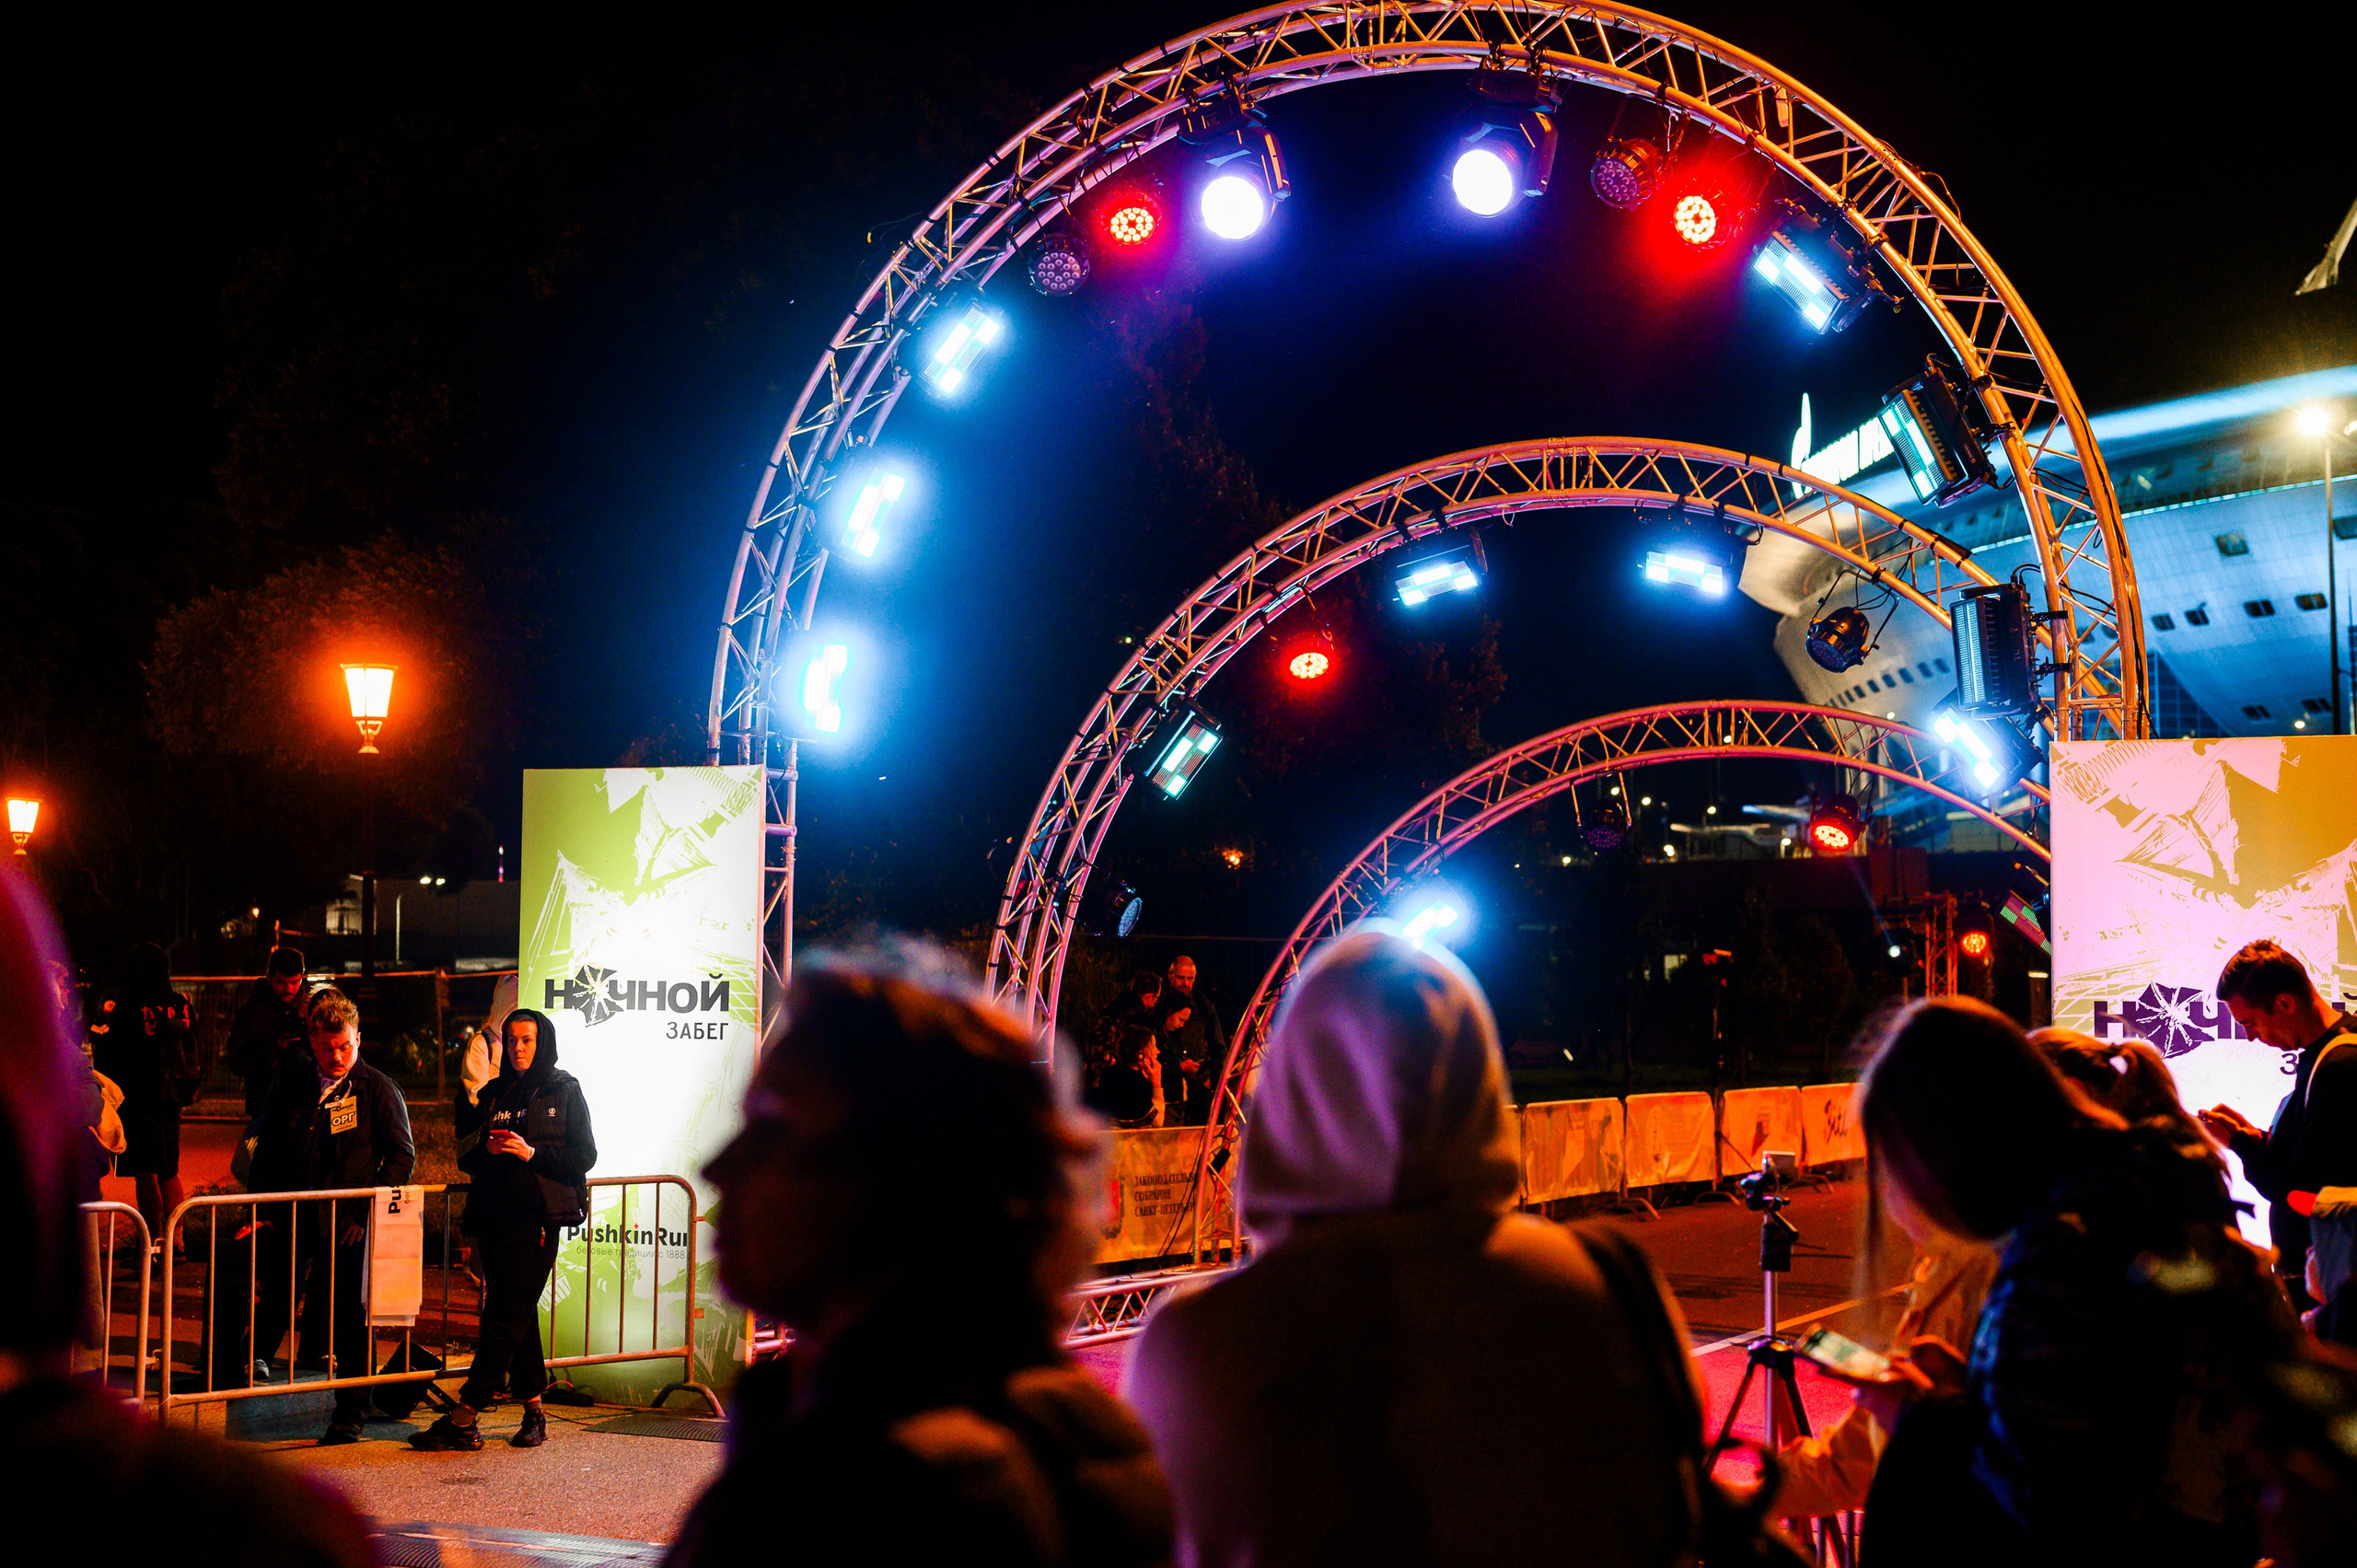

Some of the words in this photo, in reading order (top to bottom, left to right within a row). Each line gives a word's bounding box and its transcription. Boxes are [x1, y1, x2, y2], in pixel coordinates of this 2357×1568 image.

[666, 1021, 729, 1040] ЗАБЕГ
[331, 1111, 356, 1127] ОРГ
[388, 1186, 401, 1214] Pu
[576, 1246, 613, 1256] беовые
[666, 1250, 686, 1260] 1888
